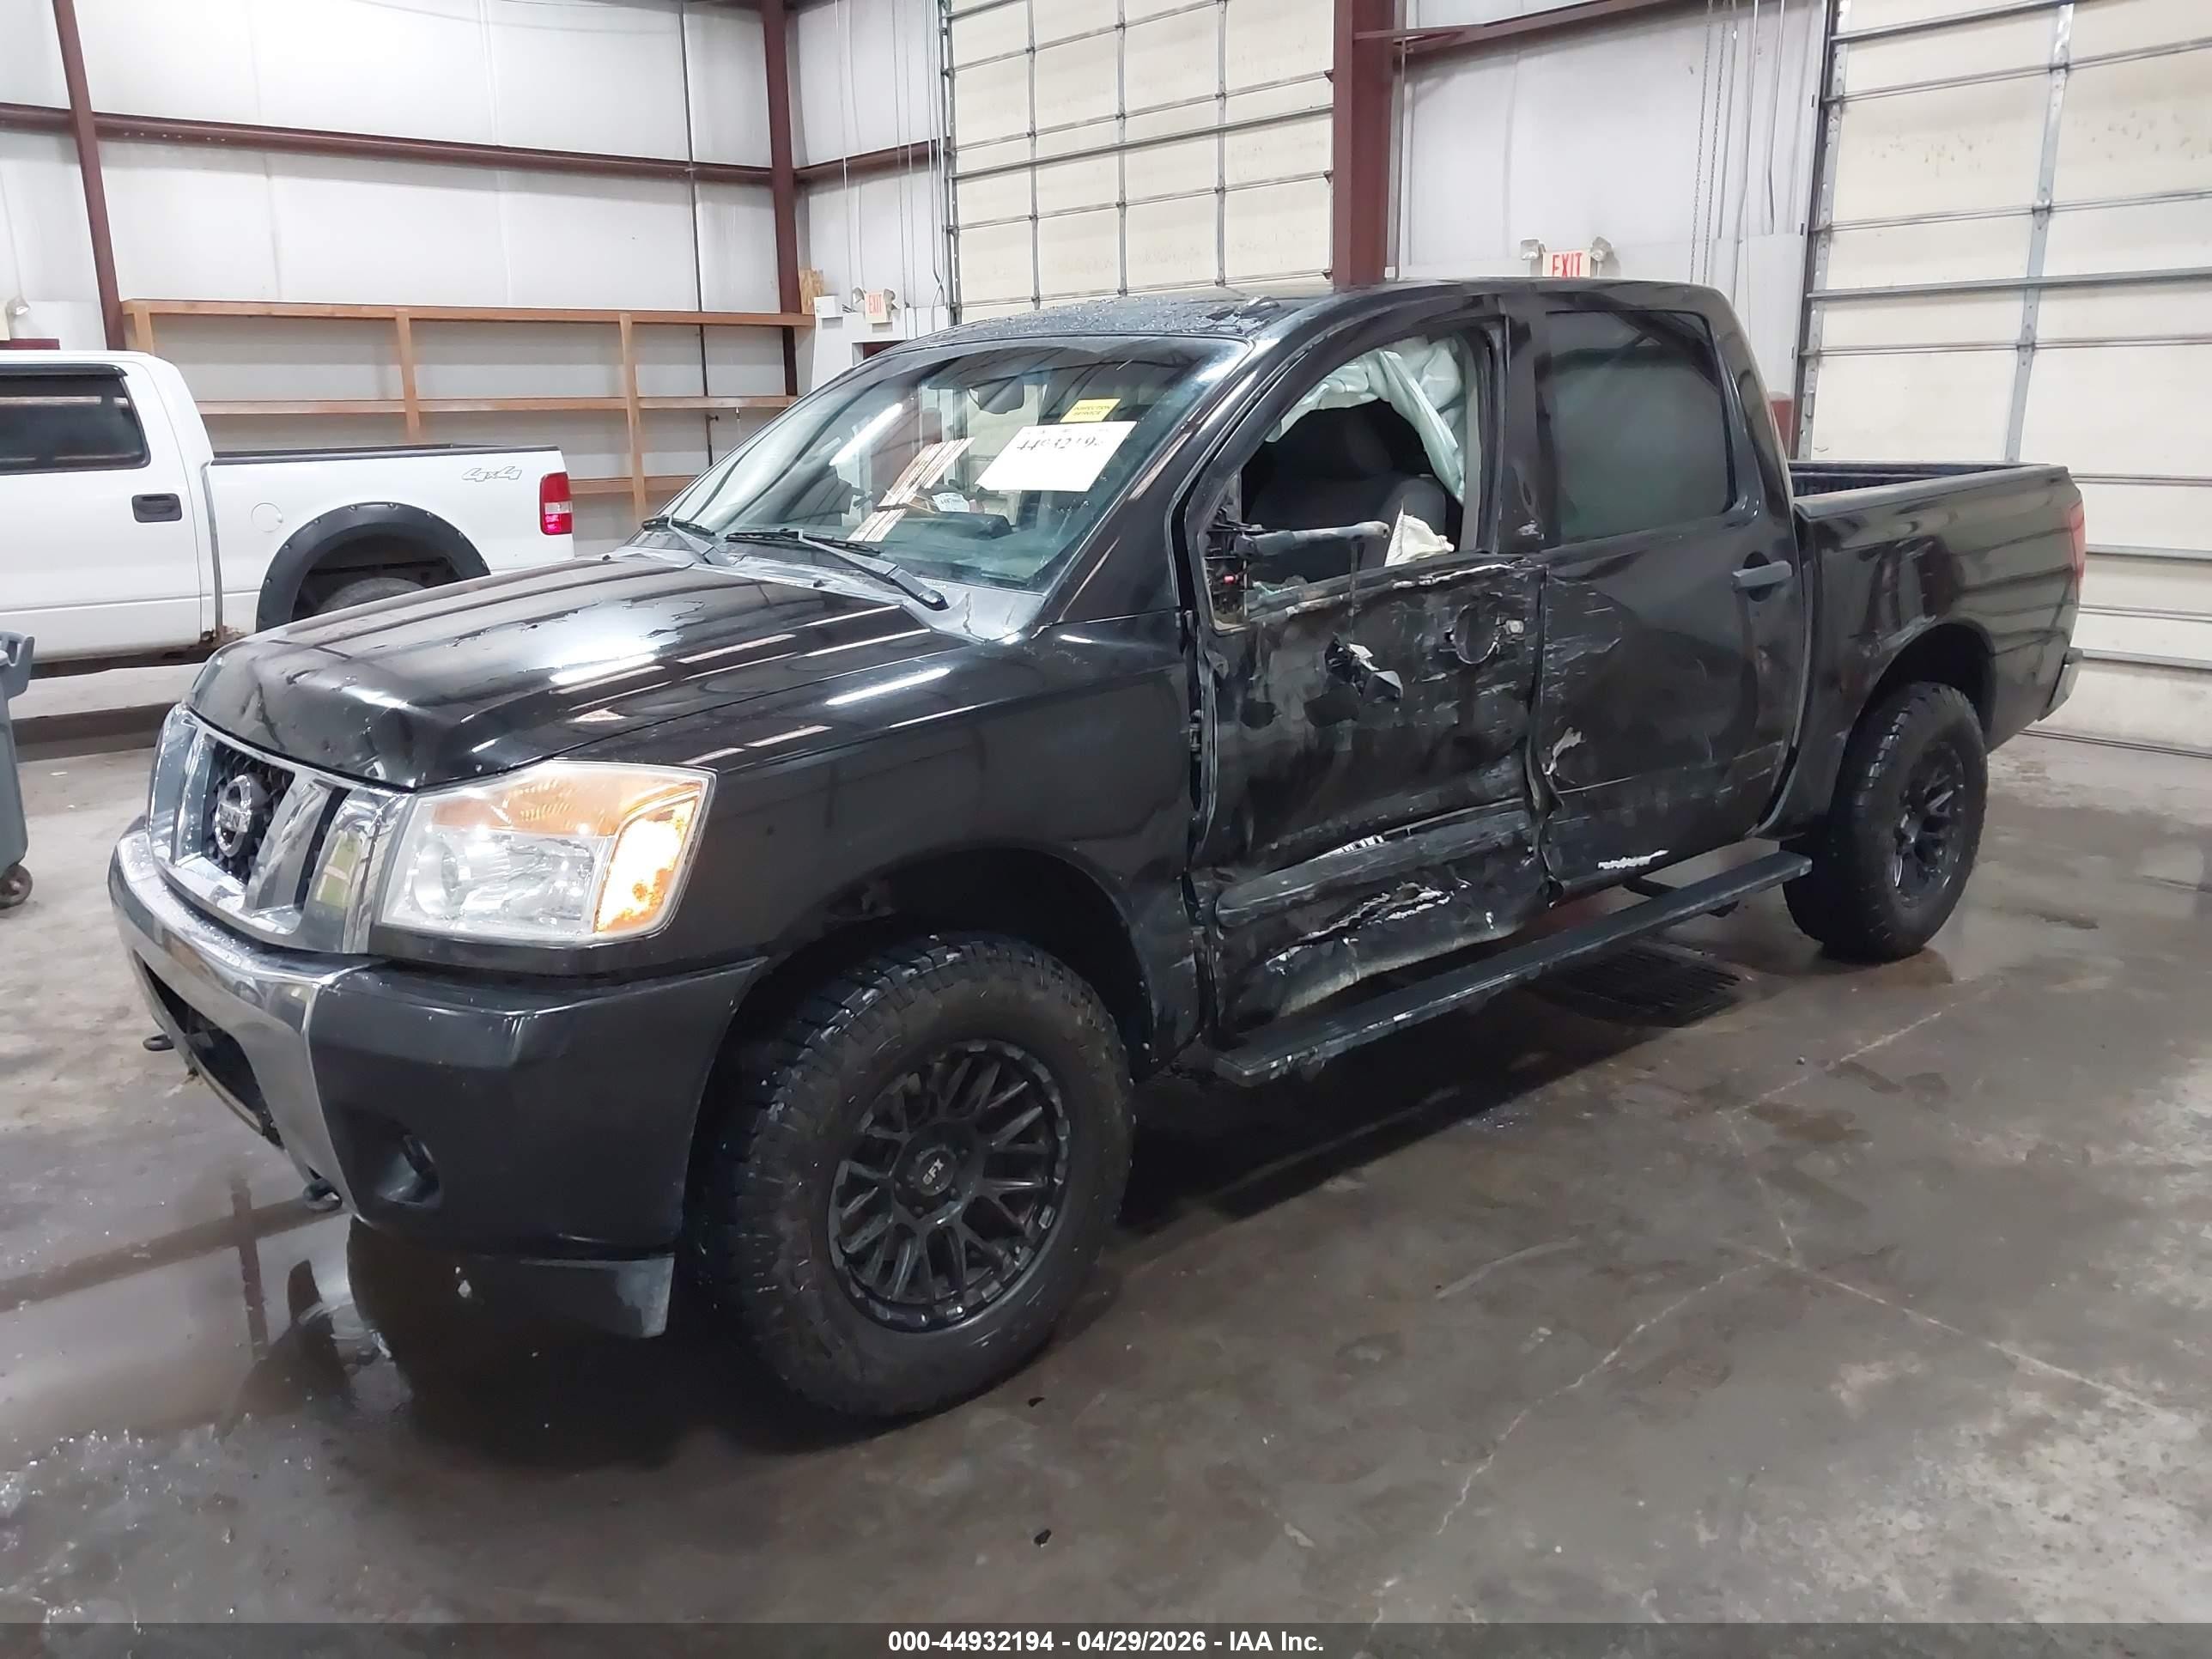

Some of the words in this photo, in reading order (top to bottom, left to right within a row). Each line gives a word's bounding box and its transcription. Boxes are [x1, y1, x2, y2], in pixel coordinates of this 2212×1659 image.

[1552, 252, 1582, 277] EXIT
[868, 294, 883, 314] EXIT
[462, 465, 522, 482] 4x4
